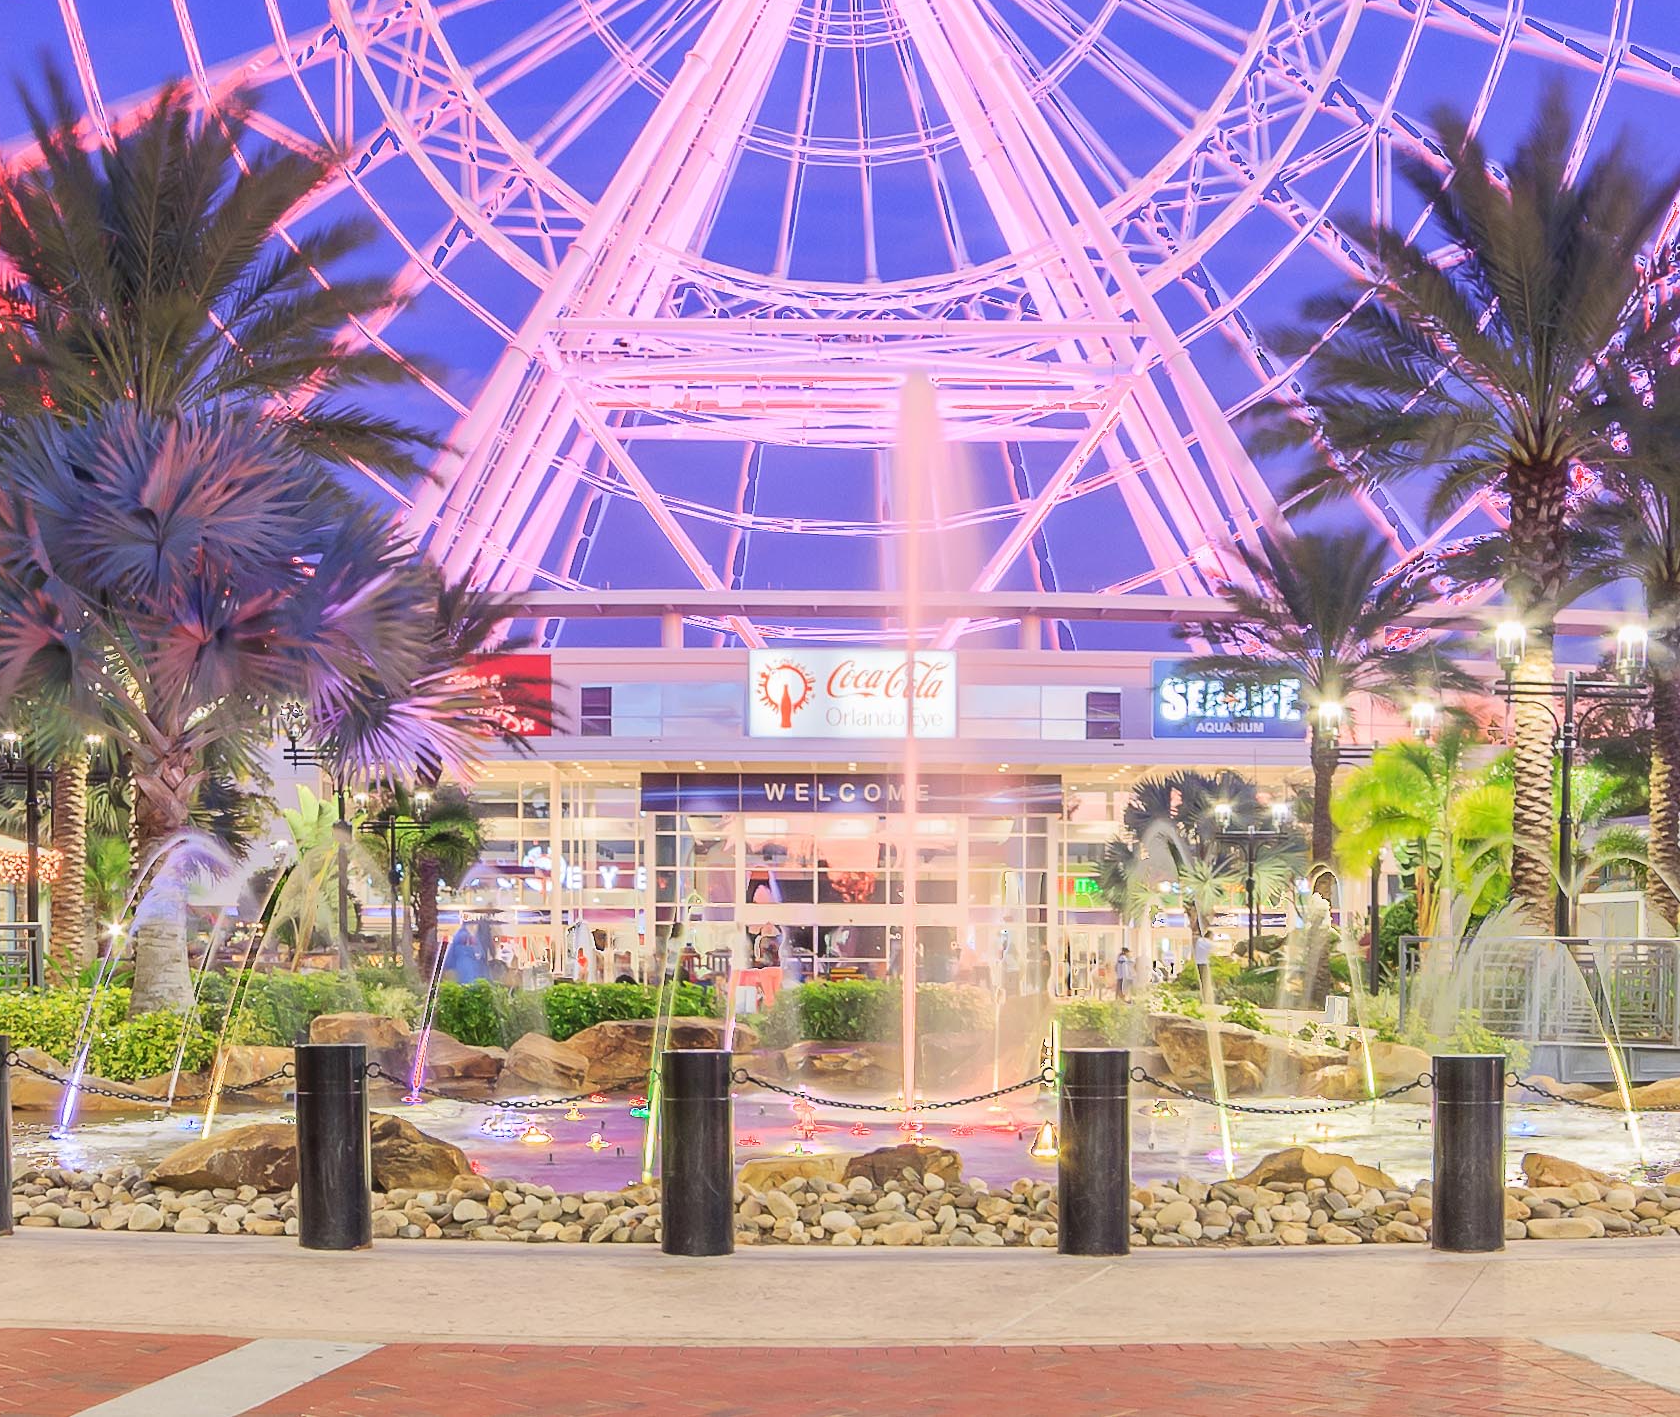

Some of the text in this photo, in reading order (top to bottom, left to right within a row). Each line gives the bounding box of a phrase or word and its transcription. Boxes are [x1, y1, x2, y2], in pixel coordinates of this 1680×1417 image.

[825, 707, 906, 727] Orlando
[1196, 722, 1264, 733] AQUARIUM
[765, 783, 929, 803] WELCOME
